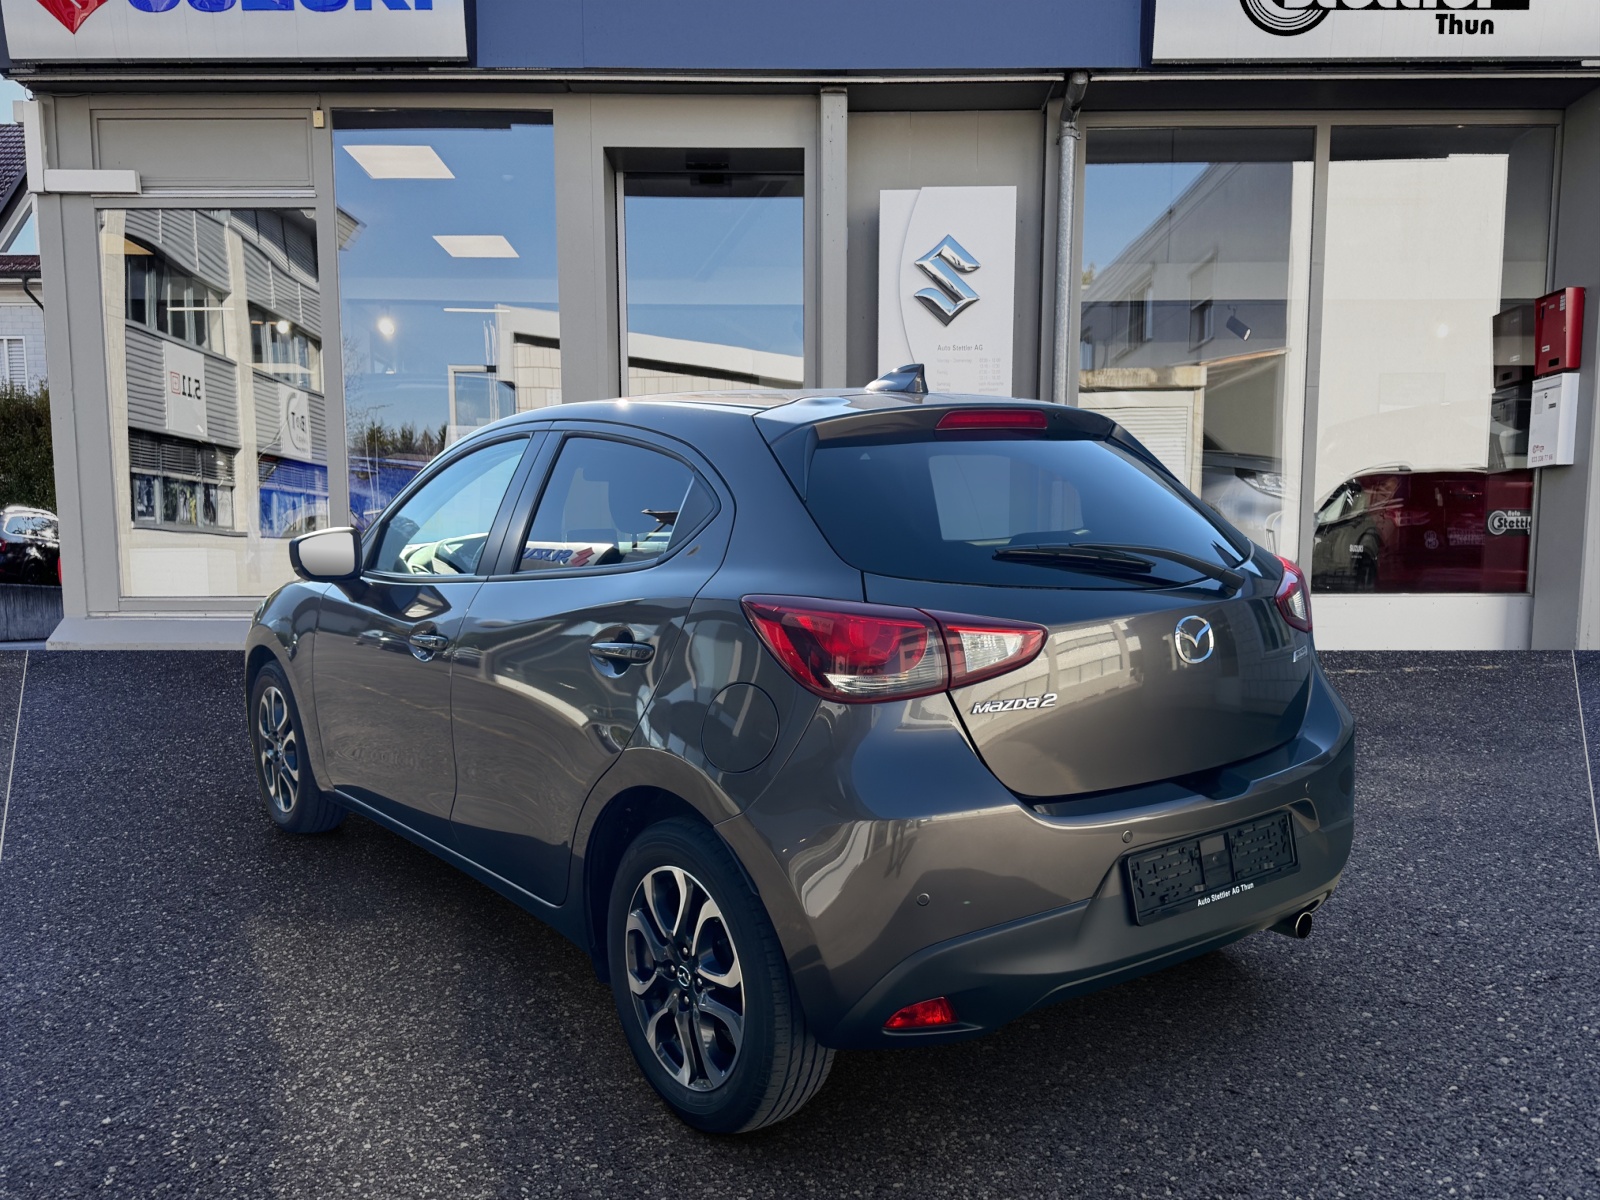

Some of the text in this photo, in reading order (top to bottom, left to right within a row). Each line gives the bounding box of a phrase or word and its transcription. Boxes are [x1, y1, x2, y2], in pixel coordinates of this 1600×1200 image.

[1435, 14, 1495, 35] Thun
[1197, 882, 1255, 907] Auto Stettler AG Thun
